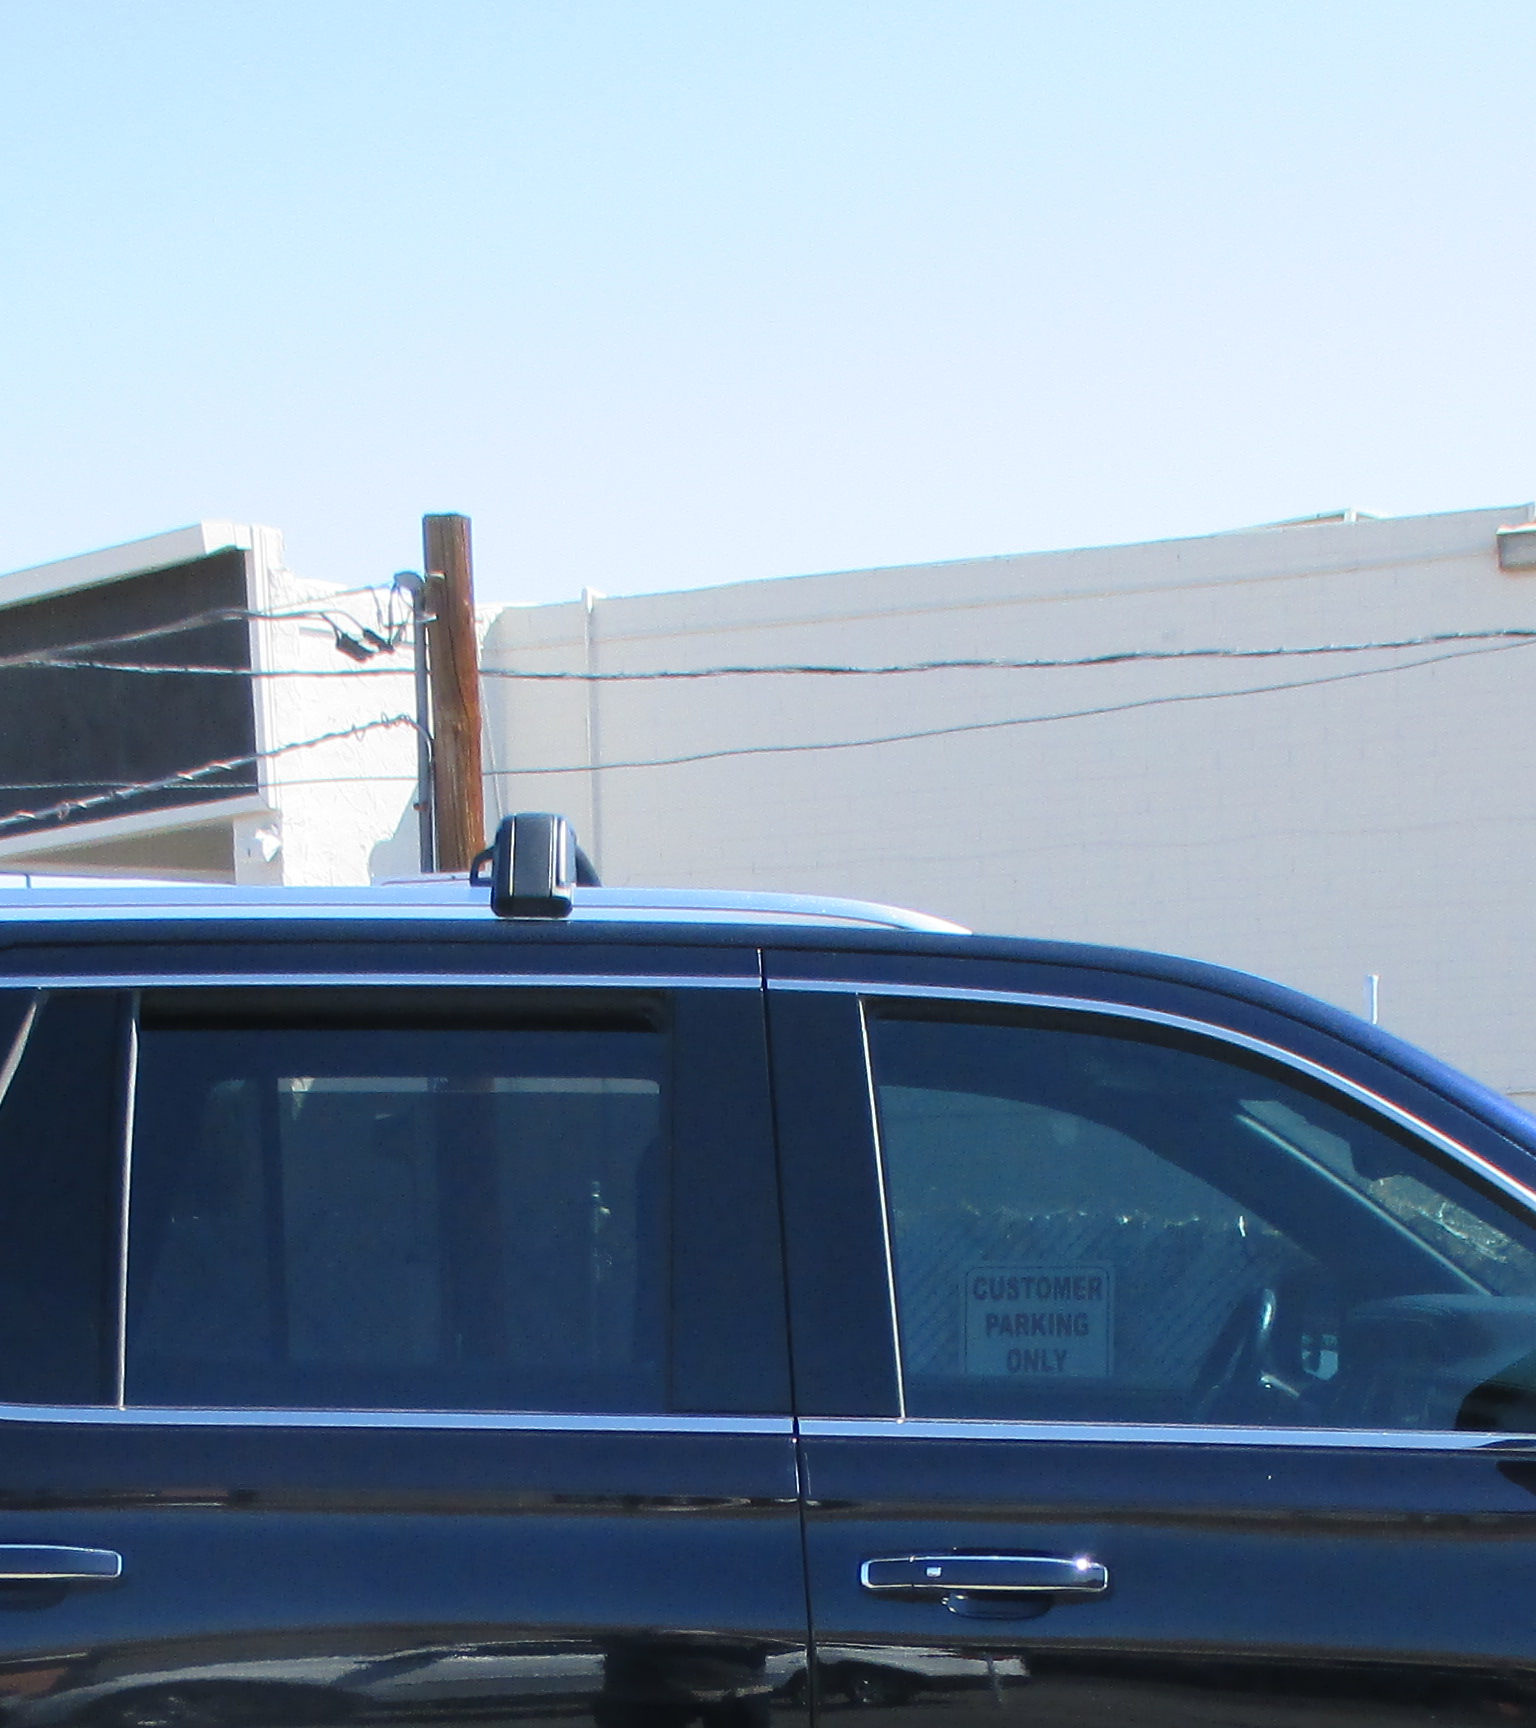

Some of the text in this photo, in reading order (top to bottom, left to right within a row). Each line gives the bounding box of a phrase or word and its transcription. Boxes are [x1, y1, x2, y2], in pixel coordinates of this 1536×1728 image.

[973, 1276, 1103, 1300] CUSTOMER
[985, 1312, 1089, 1336] PARKING
[1007, 1349, 1067, 1374] ONLY
